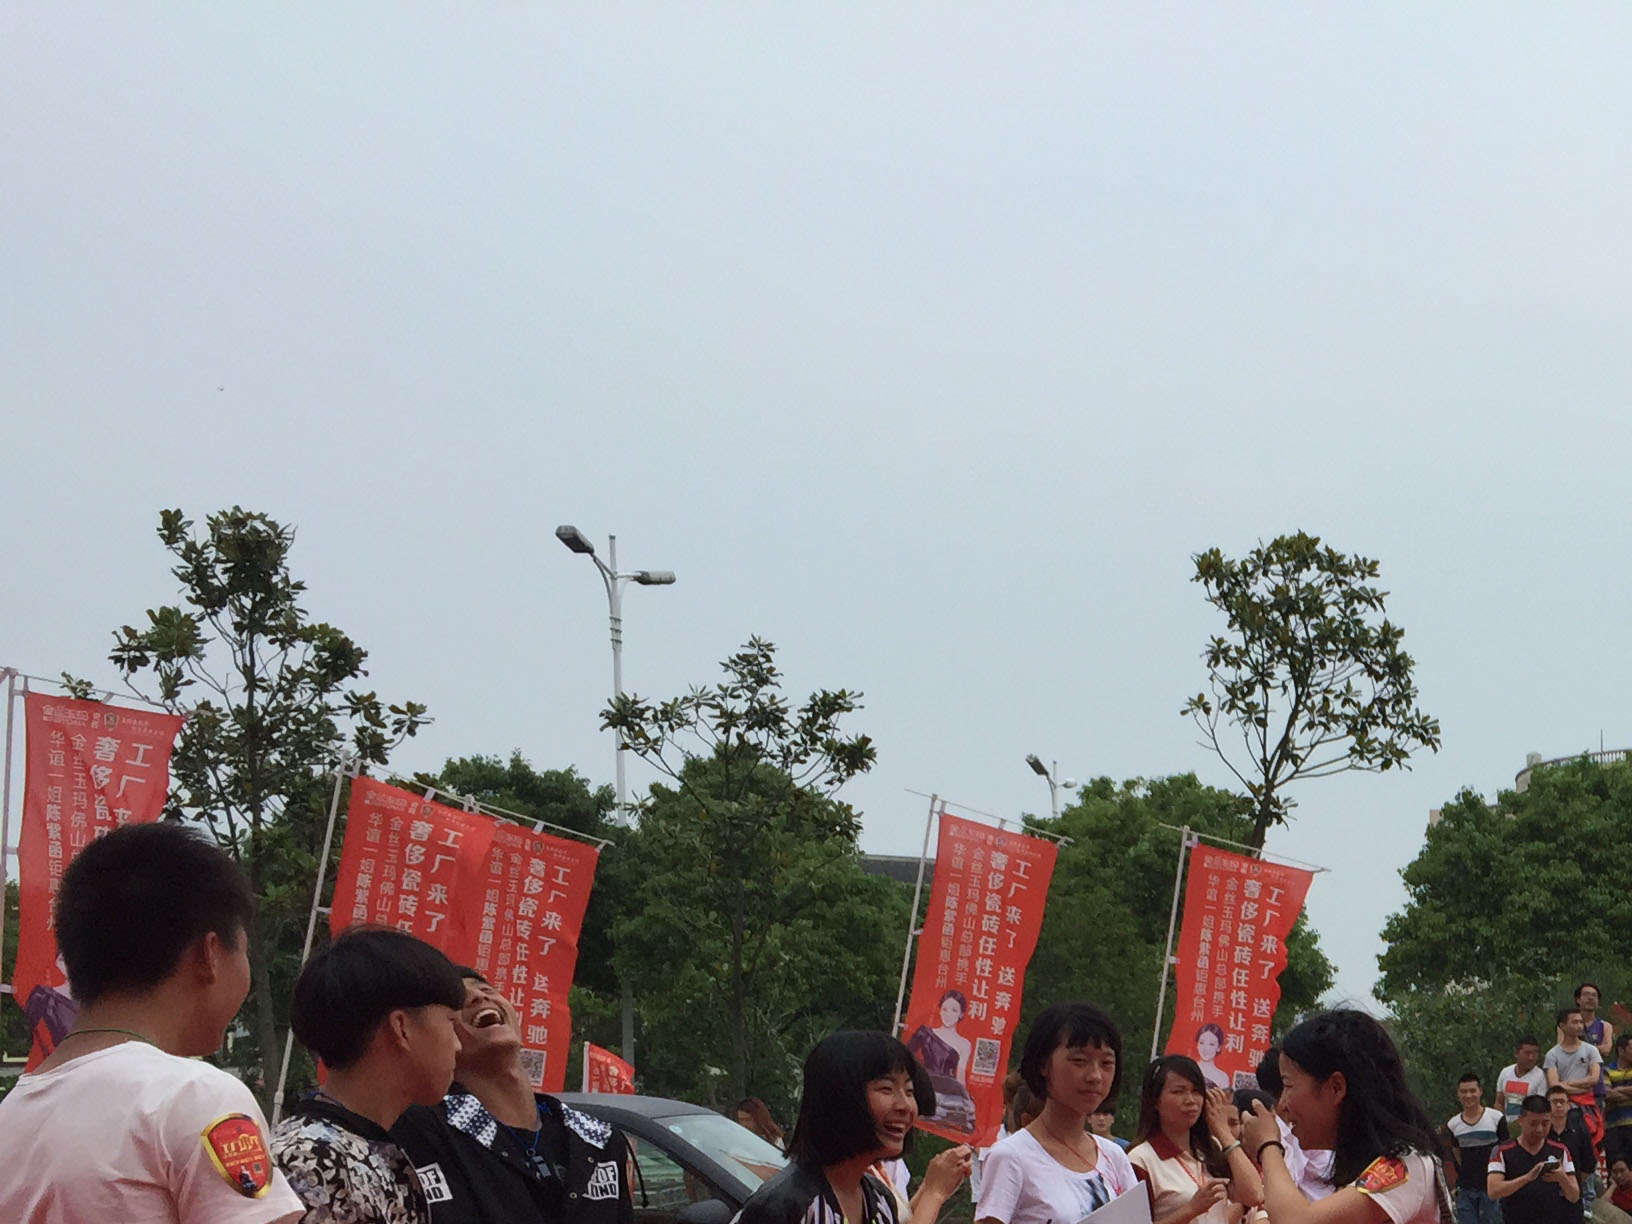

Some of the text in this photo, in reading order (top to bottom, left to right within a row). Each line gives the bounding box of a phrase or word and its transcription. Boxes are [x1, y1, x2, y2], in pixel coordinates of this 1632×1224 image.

[352, 812, 383, 925] 华谊一姐陈紫函
[425, 828, 464, 933] 工厂来了
[1005, 859, 1031, 949] 工厂来了
[526, 865, 571, 1045] 工厂来了 送奔驰
[968, 851, 1009, 1021] 奢侈瓷砖任性让利
[1225, 879, 1262, 1054] 奢侈瓷砖任性让利
[1258, 886, 1284, 980] 工厂来了
[990, 966, 1016, 1036] 送奔驰
[1248, 998, 1271, 1068] 送奔驰
